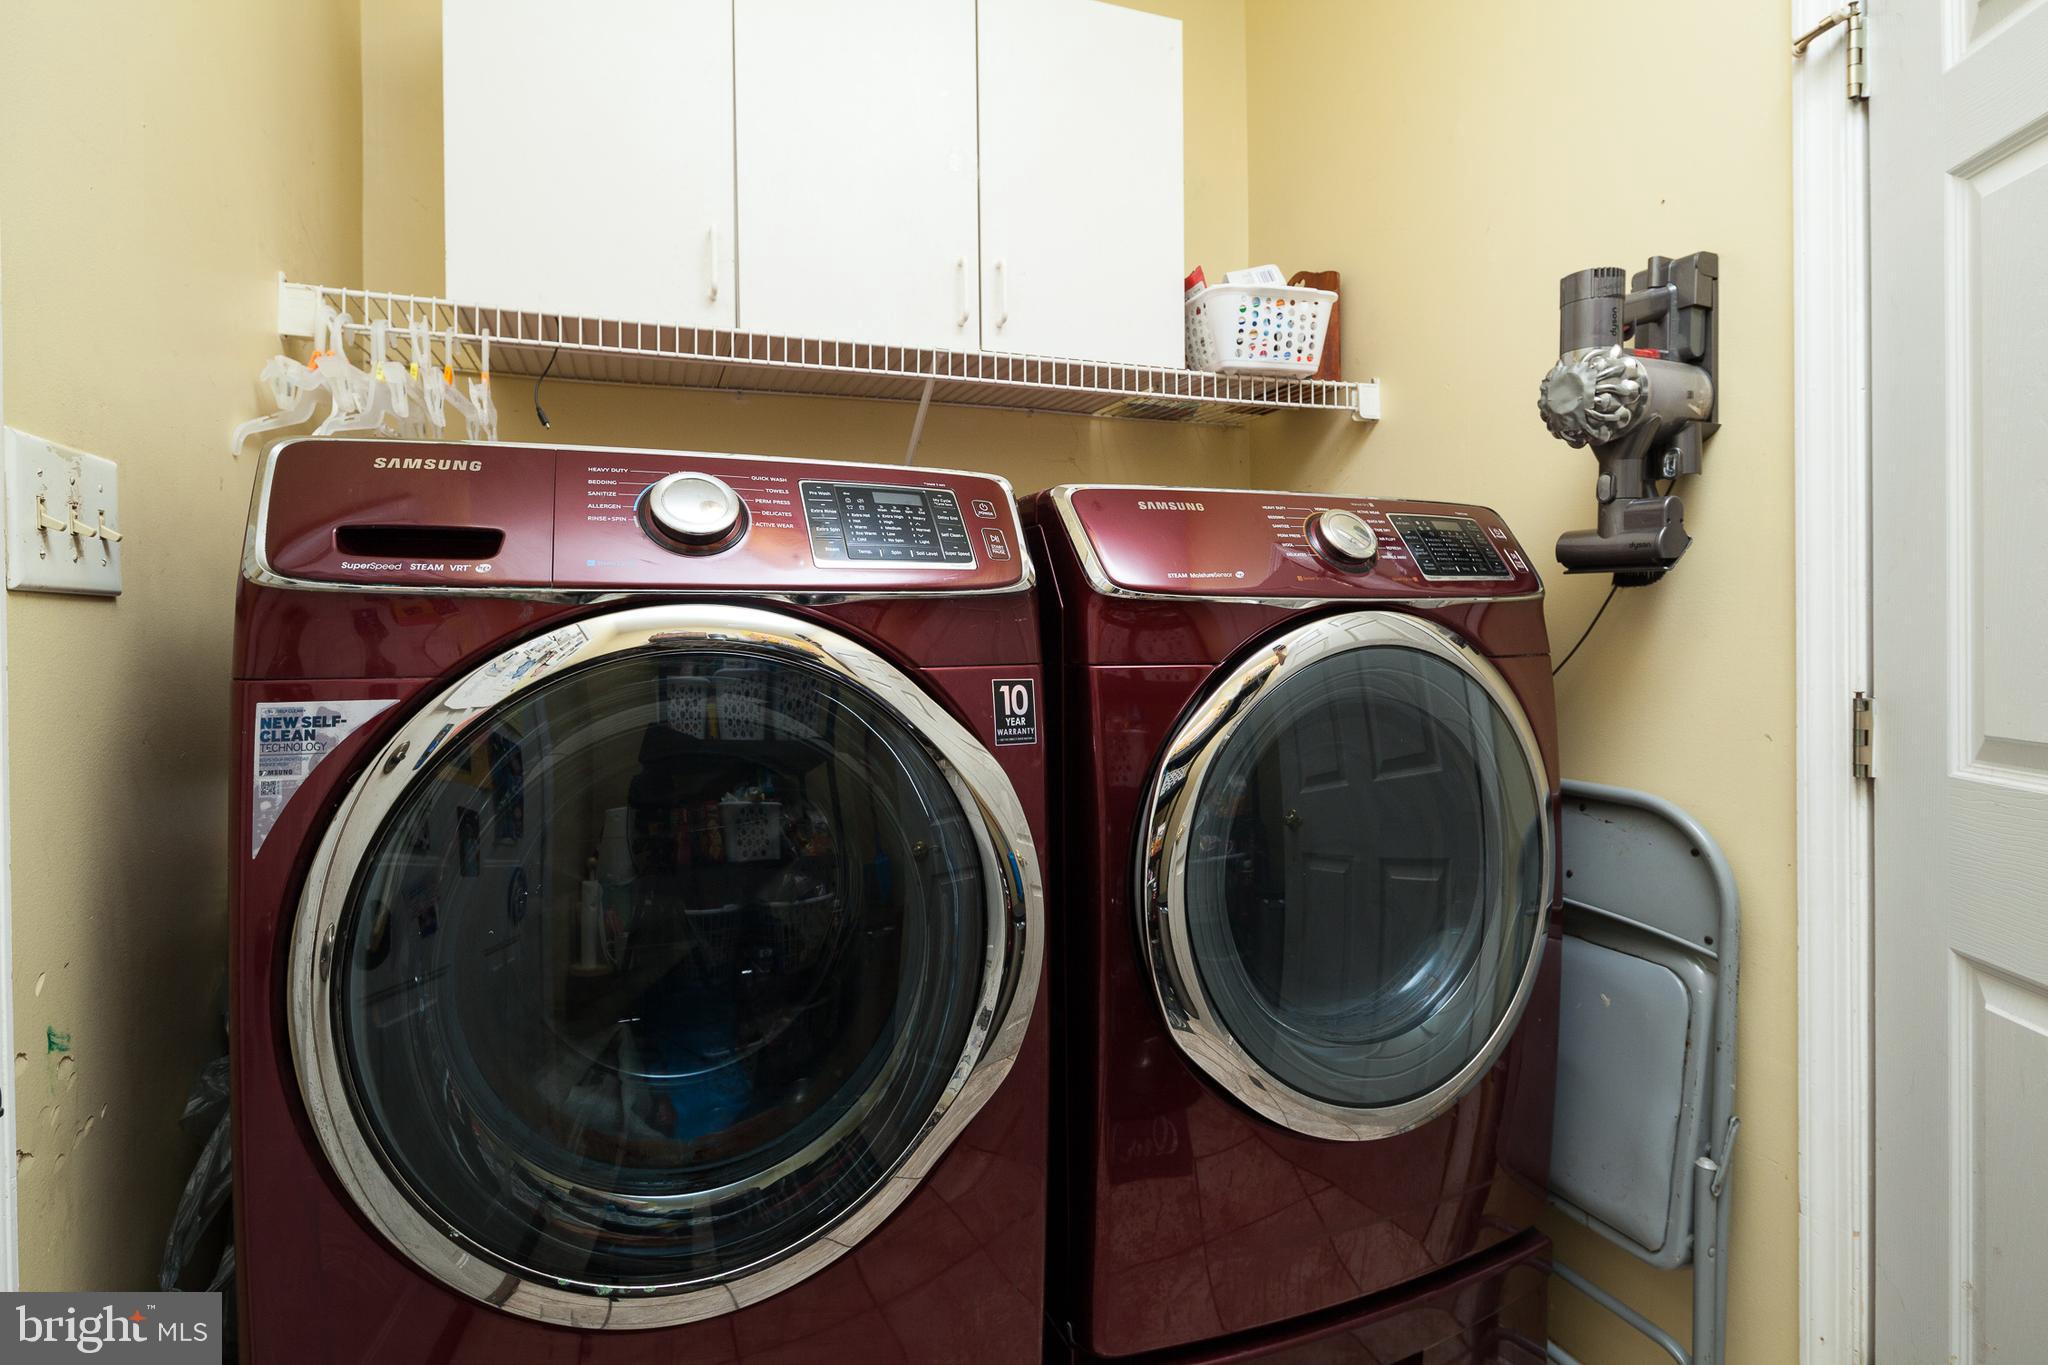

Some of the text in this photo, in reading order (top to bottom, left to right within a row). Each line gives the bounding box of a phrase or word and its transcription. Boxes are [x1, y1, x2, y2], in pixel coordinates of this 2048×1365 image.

[373, 457, 482, 472] SAMSUNG
[1138, 500, 1205, 512] SAMSUNG
[340, 562, 402, 571] SuperSpeed
[1000, 684, 1028, 716] 10
[260, 715, 347, 729] NEW SELF-
[1005, 717, 1026, 726] YEAR
[260, 729, 316, 742] CLEAN
[997, 728, 1034, 736] WARRANTY
[260, 742, 327, 753] TECHNOLOGY
